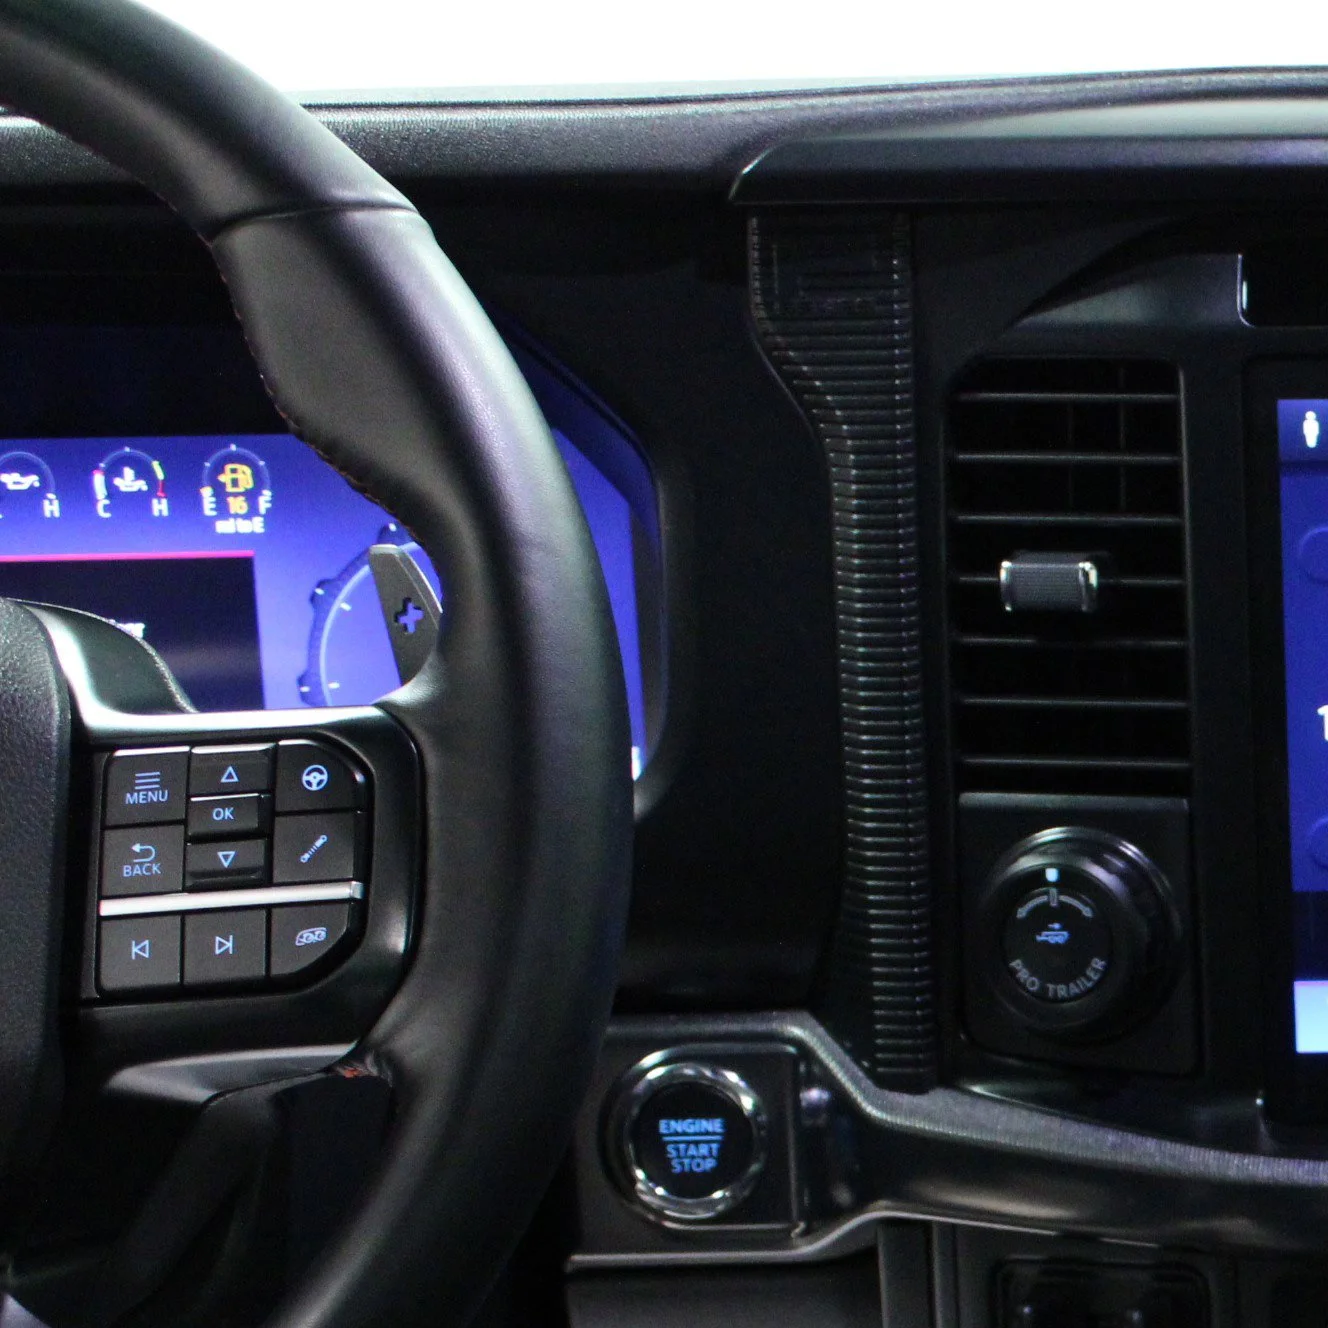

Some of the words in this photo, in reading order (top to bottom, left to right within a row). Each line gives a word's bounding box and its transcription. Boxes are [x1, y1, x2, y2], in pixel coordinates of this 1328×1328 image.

[43, 499, 60, 518] H
[97, 499, 112, 518] C
[152, 498, 169, 517] H
[125, 790, 169, 804] MENU
[212, 807, 234, 820] OK
[123, 863, 161, 877] BACK
[1009, 959, 1040, 991] PRO
[1047, 957, 1107, 998] TRAILER
[658, 1118, 725, 1134] ENGINE
[666, 1144, 721, 1158] START
[671, 1159, 718, 1174] STOP
